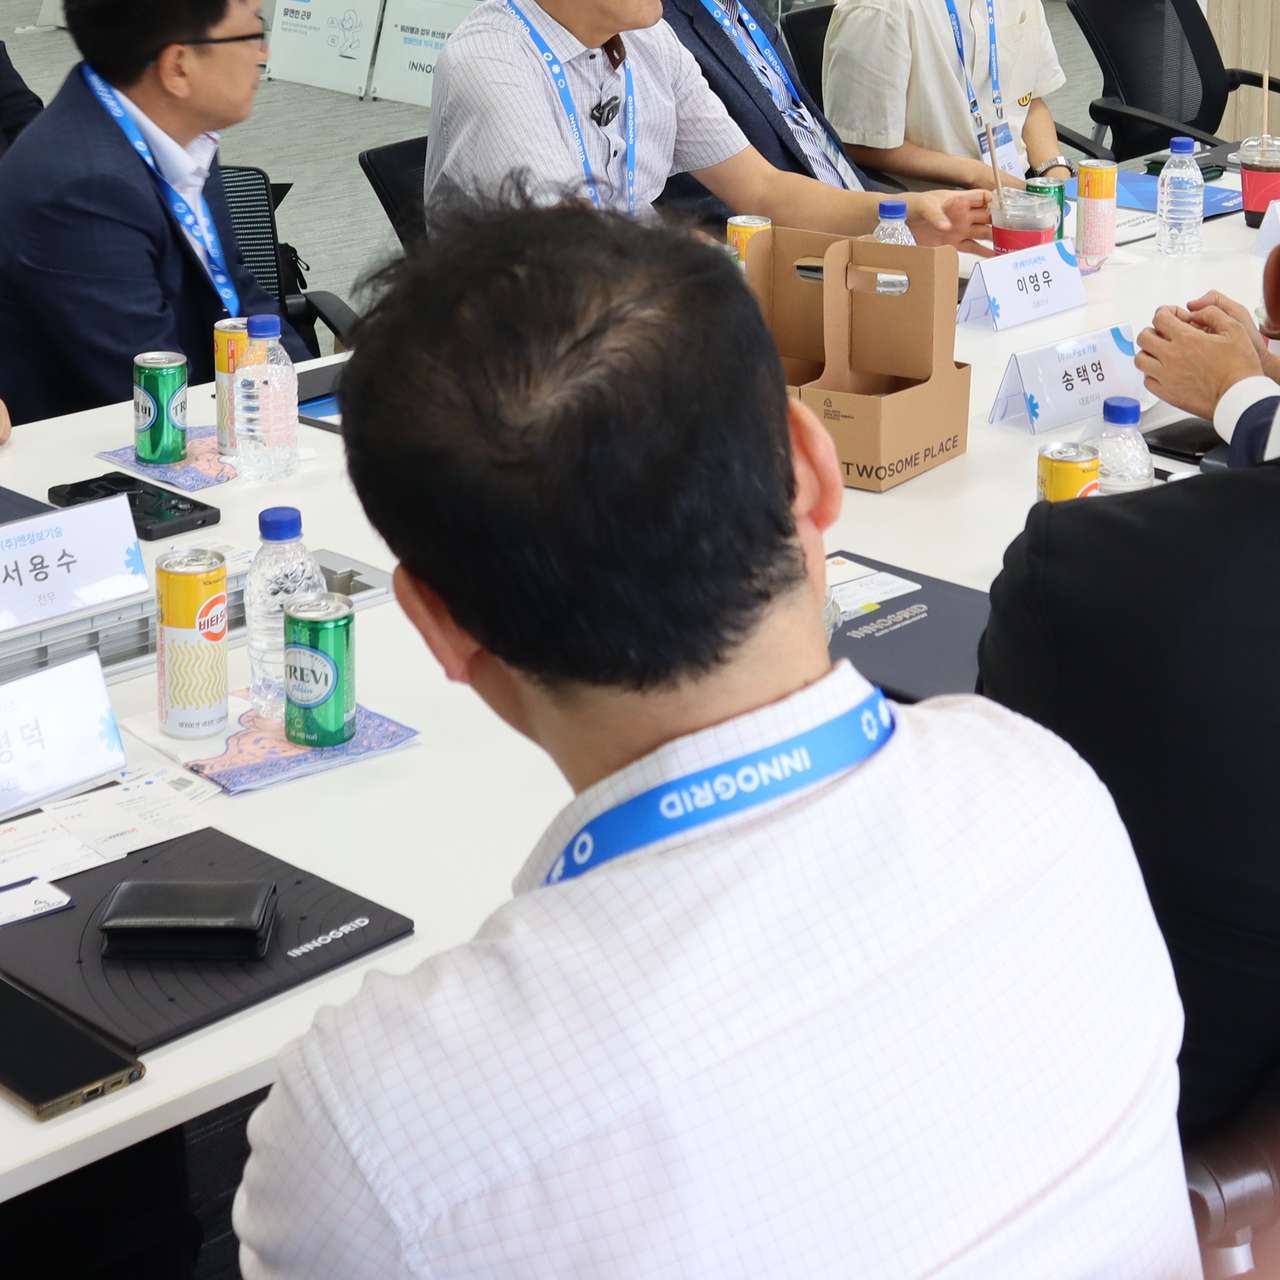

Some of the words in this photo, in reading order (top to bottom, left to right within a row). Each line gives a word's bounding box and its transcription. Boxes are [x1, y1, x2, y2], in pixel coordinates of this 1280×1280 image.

[568, 112, 587, 164] INNOGRID
[1016, 270, 1054, 295] 이영우
[1062, 360, 1106, 392] 송택영
[841, 451, 920, 481] TWOSOME
[923, 434, 959, 463] PLACE
[0, 526, 65, 552] (주)엔정보기술
[2, 548, 78, 587] 서용수
[658, 746, 811, 820] INNOGRID
[285, 915, 371, 959] INNOGRID
